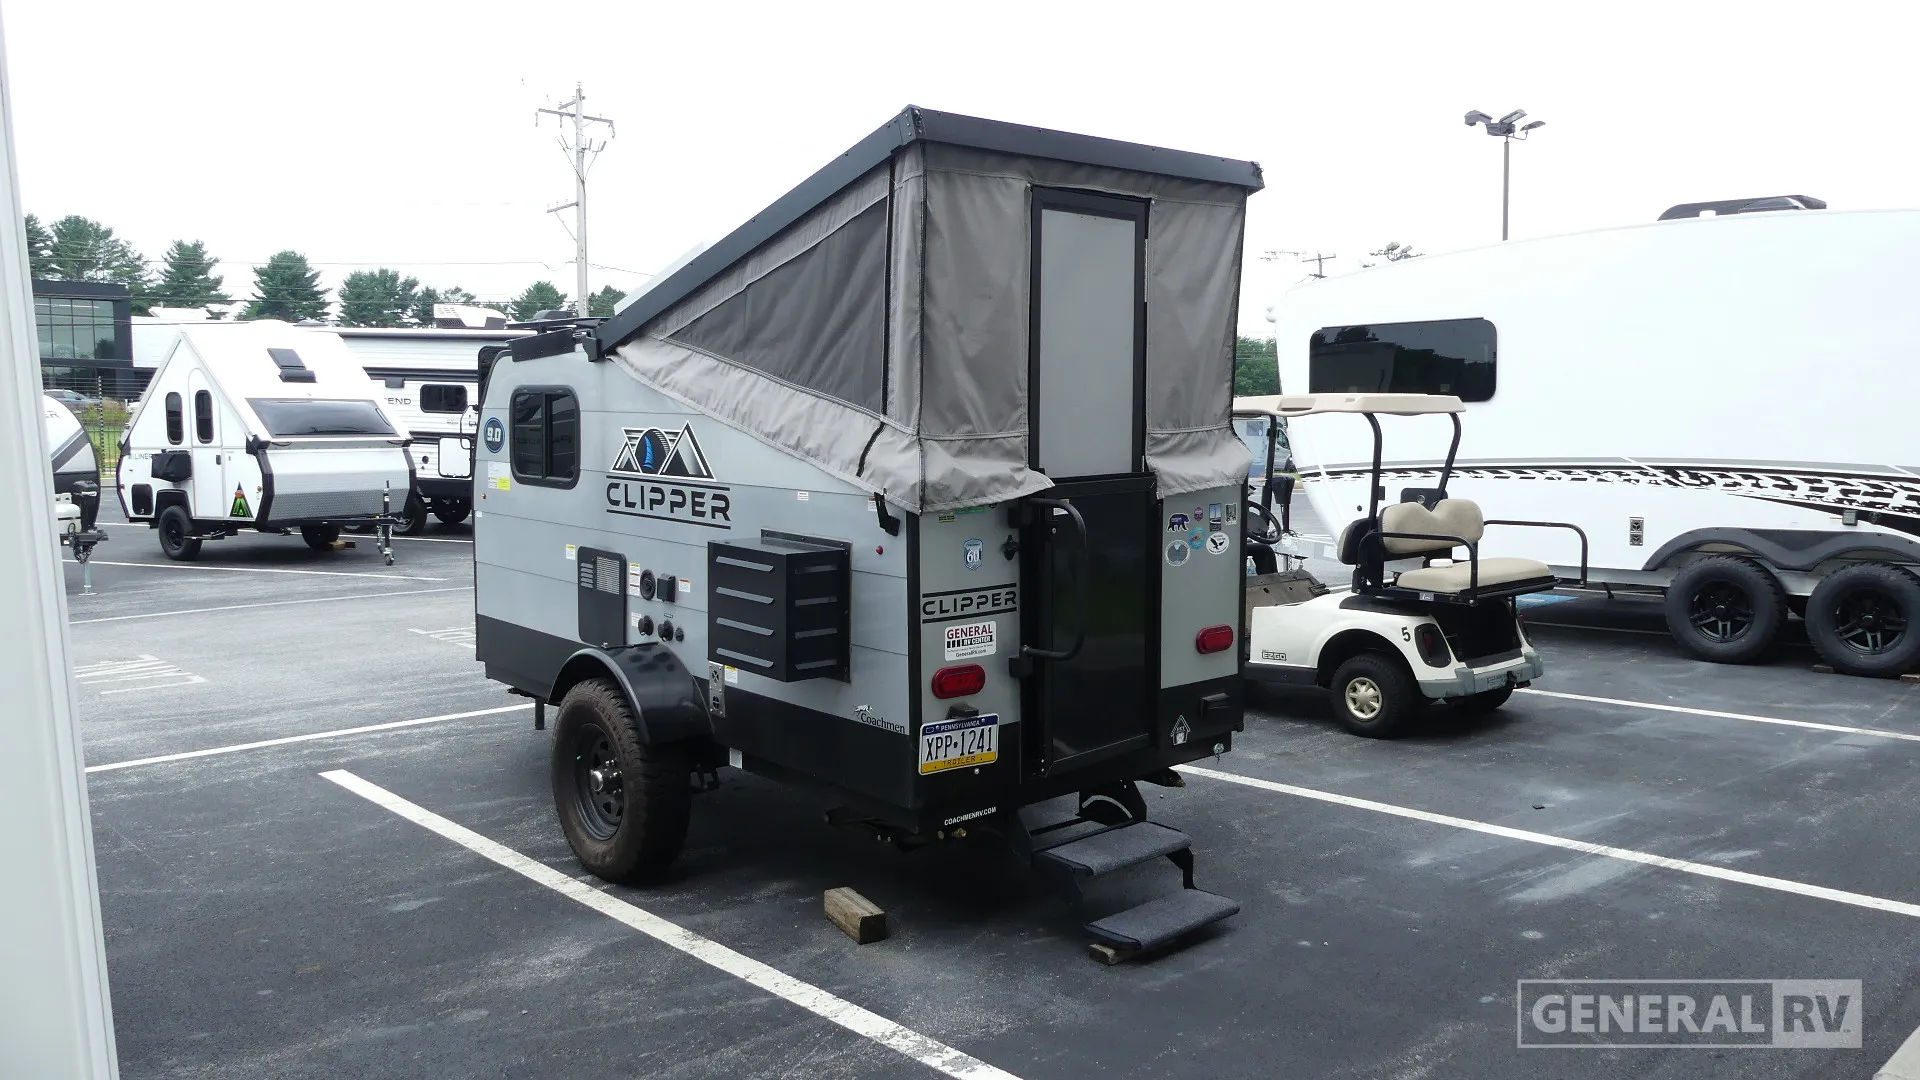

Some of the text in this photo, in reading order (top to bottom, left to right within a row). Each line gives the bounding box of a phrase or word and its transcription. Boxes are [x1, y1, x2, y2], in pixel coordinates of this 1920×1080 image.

[383, 397, 412, 405] END
[486, 427, 502, 442] 9.0
[606, 482, 731, 522] CLIPPER
[966, 549, 980, 563] 60
[922, 590, 1017, 616] CLIPPER
[946, 623, 993, 640] GENERAL
[1400, 626, 1411, 642] 5
[963, 636, 991, 647] RV CENTER
[860, 712, 906, 734] Coachmen
[940, 720, 980, 732] PENNSYLVANIA
[944, 806, 997, 826] COACHMENRV.COM
